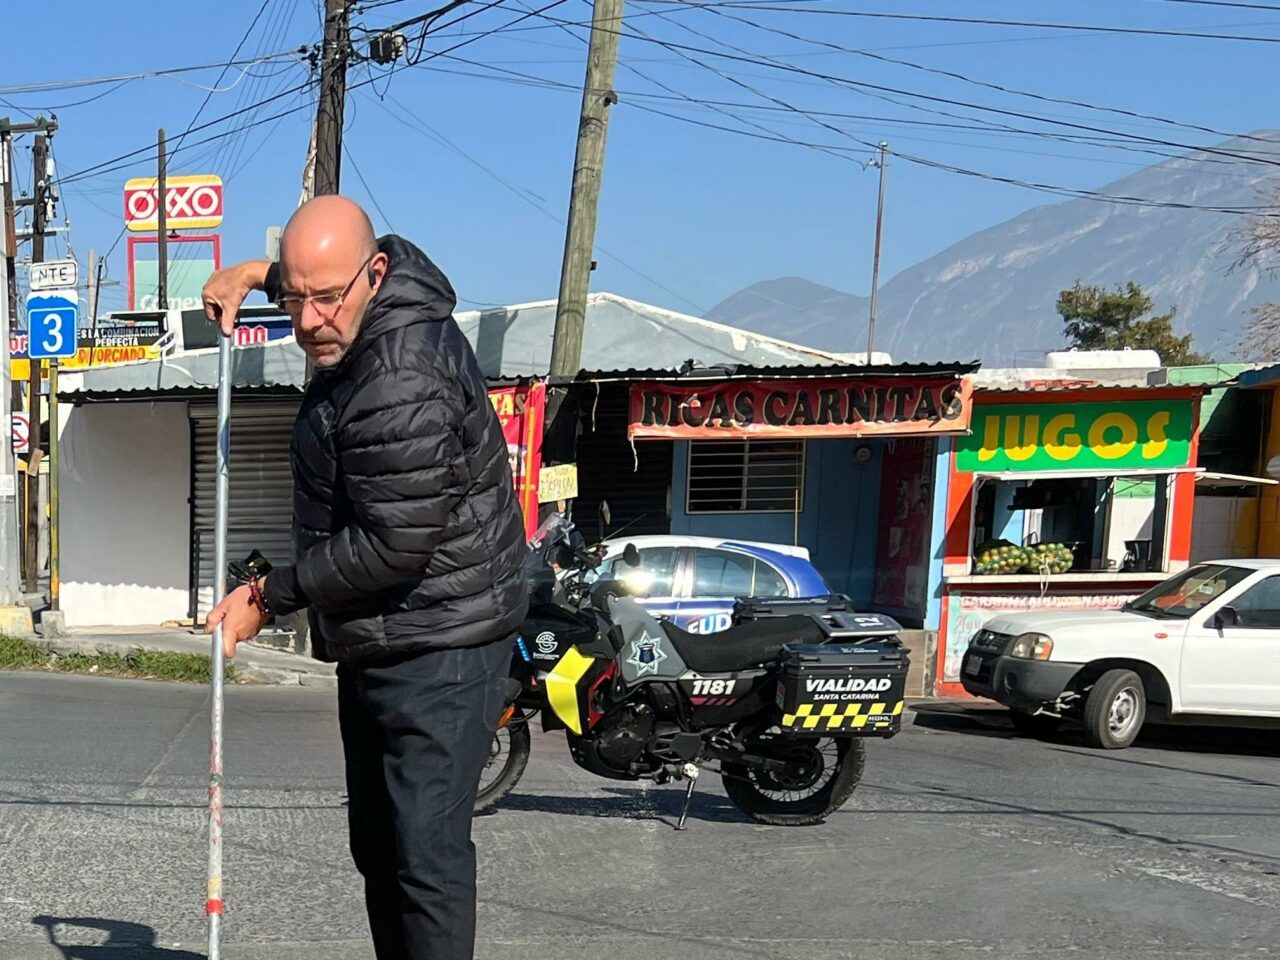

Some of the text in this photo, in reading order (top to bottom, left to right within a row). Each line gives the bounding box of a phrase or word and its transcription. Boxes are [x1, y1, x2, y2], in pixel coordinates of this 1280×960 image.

[128, 186, 219, 219] OXXO
[39, 267, 67, 282] NTE
[42, 313, 63, 353] 3
[101, 327, 160, 338] COMBINACION
[95, 337, 139, 347] PERFECTA
[641, 383, 963, 428] RICAS CARNITAS
[978, 411, 1170, 462] JUGOS
[692, 680, 736, 695] 1181
[806, 678, 892, 692] VIALIDAD
